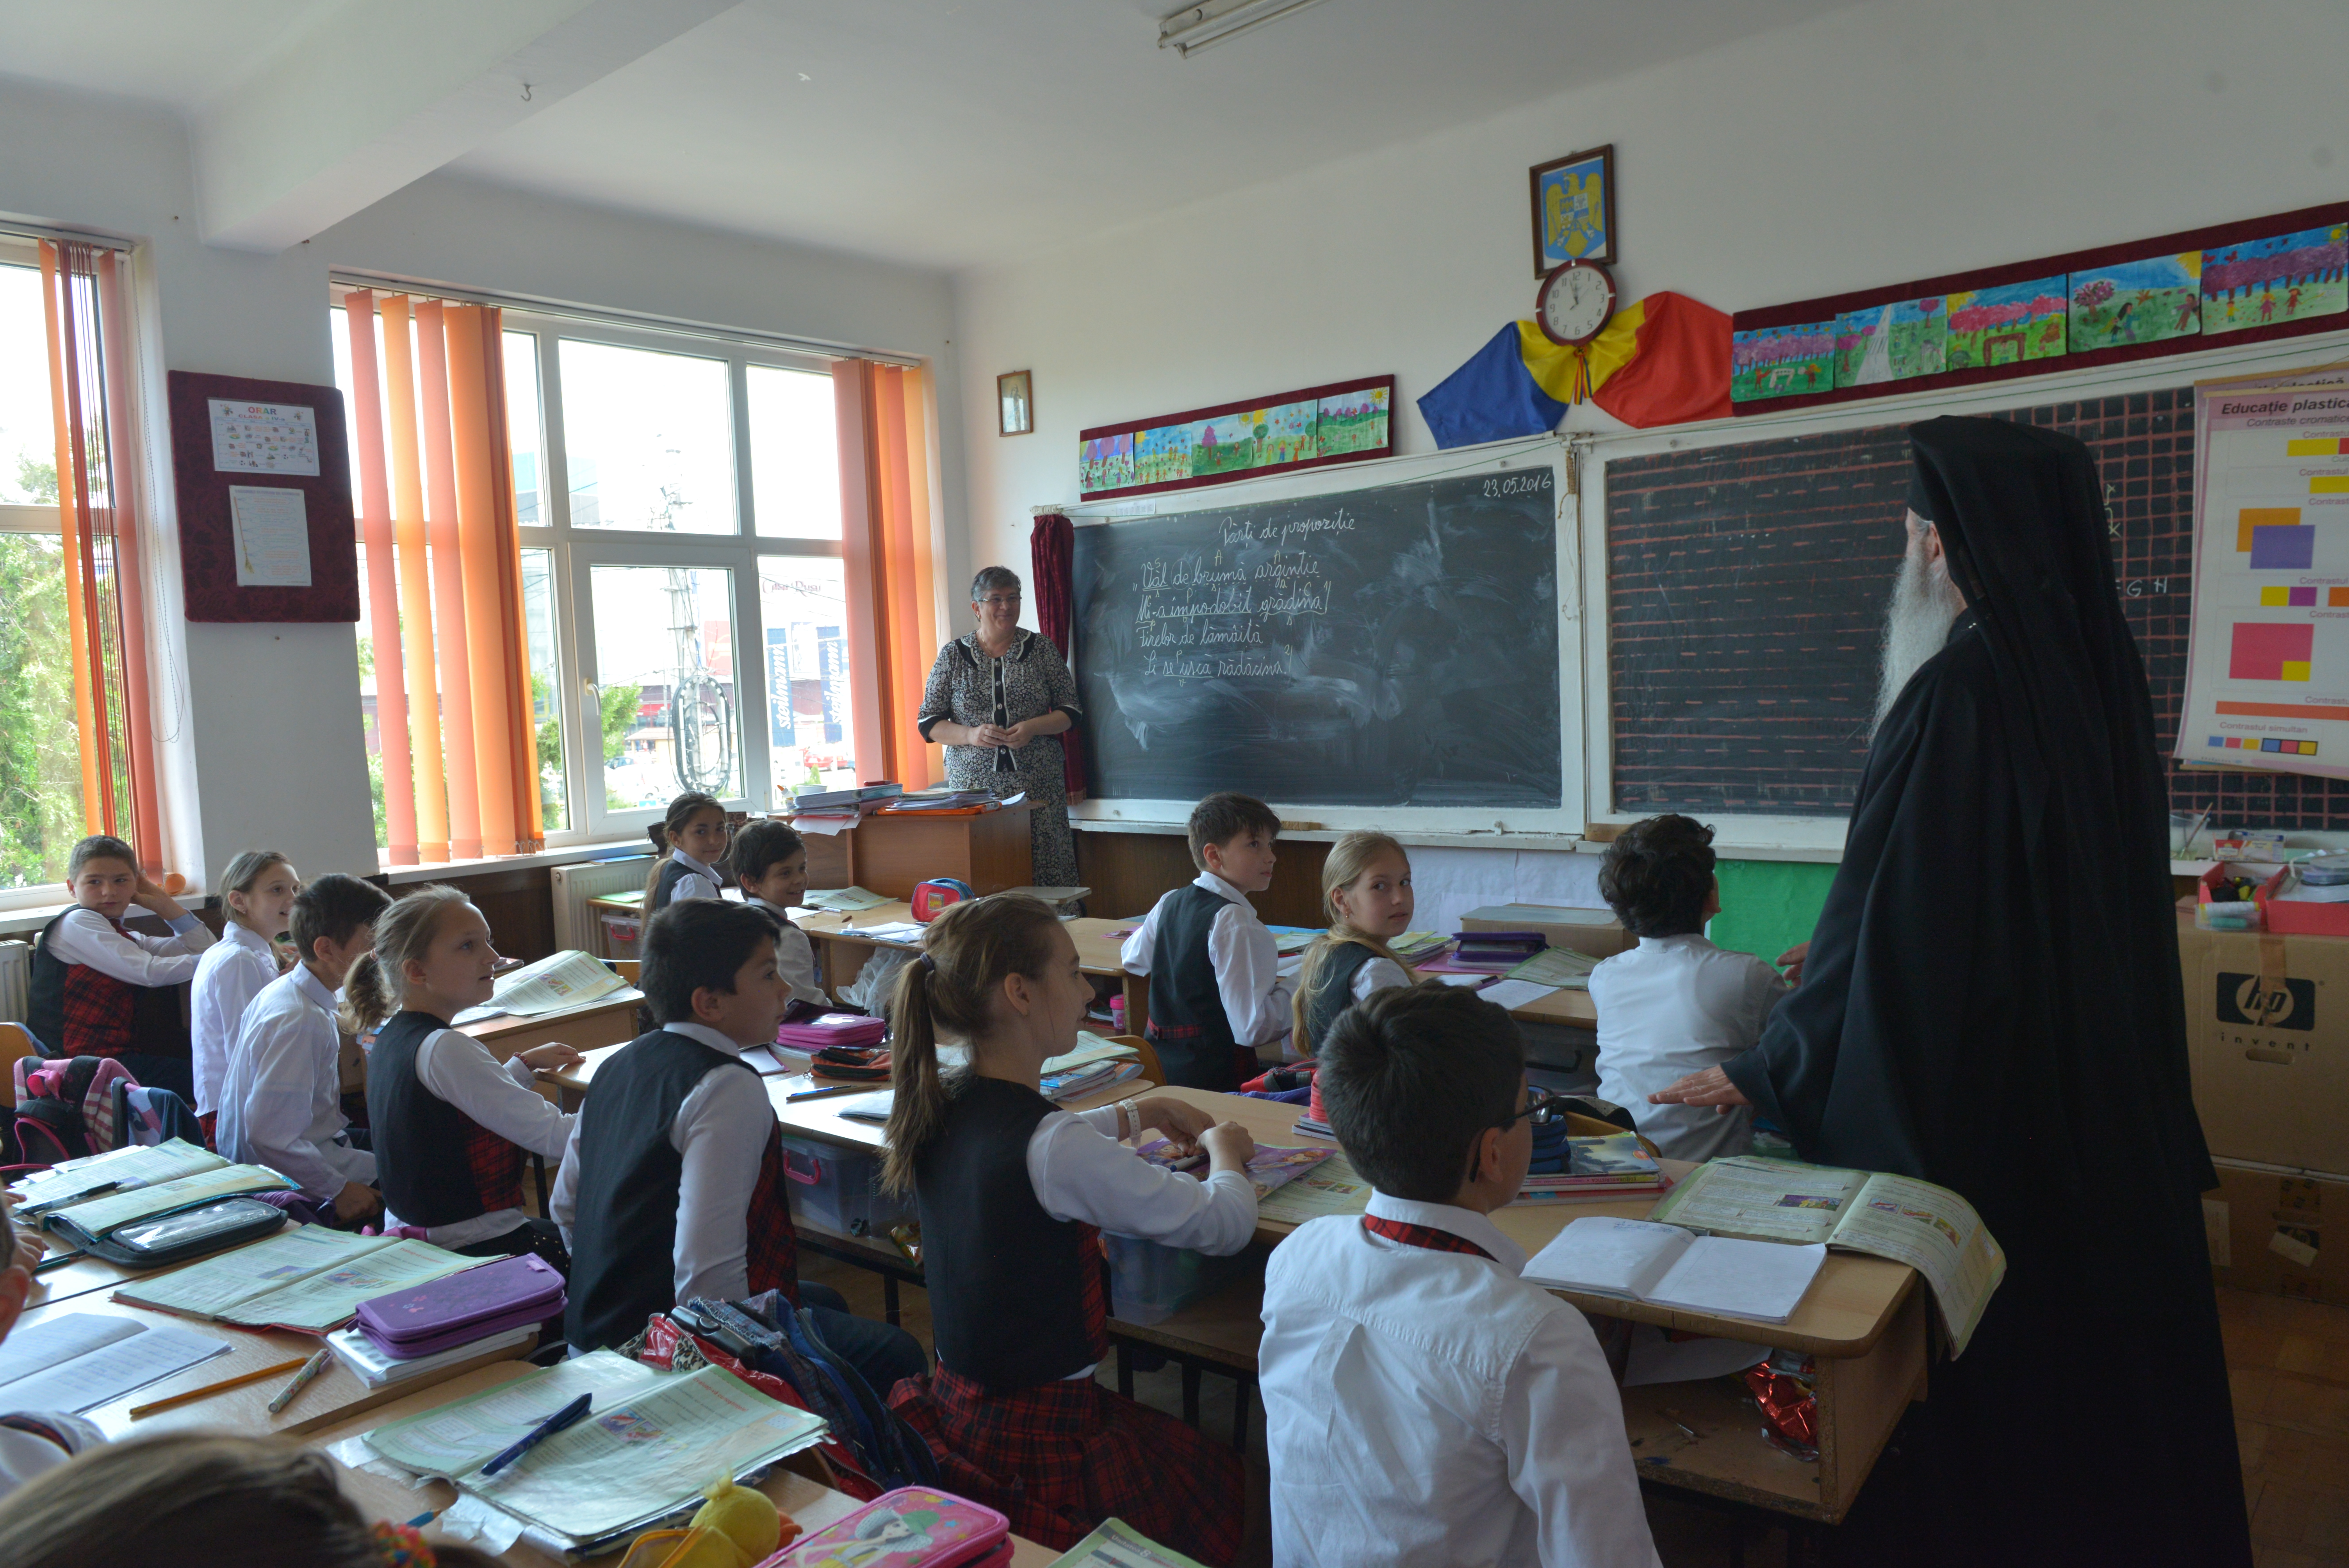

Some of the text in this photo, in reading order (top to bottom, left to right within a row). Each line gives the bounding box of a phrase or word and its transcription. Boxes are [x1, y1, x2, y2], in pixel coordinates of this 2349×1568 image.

[1573, 272, 1581, 281] 12
[1588, 273, 1591, 282] 1
[1562, 278, 1567, 287] 11
[1596, 280, 1601, 290] 2
[1552, 290, 1559, 298] 10
[1600, 294, 1605, 303] 3
[1550, 304, 1555, 312] 9
[1597, 308, 1601, 317] 4
[1554, 317, 1559, 326] 8
[1588, 320, 1593, 329] 5
[1563, 325, 1567, 334] 7
[1575, 326, 1580, 335] 6
[248, 406, 276, 415] ORAR
[2222, 401, 2288, 415] Educație
[2247, 417, 2297, 427] Contraste
[1484, 474, 1551, 497] 23.05.2016
[1260, 517, 1278, 538] de
[1173, 561, 1188, 585] de
[1192, 556, 1247, 583] brumă
[1255, 550, 1319, 588] argintie
[2127, 579, 2142, 597] G
[2154, 577, 2167, 593] H
[1171, 585, 1252, 624] împodobit
[1178, 624, 1194, 645] de
[1162, 661, 1173, 675] se
[771, 644, 791, 729] steilmann
[824, 641, 842, 723] steilmann
[2269, 725, 2308, 734] simultan
[2221, 1032, 2310, 1051] invent
[1112, 1534, 1152, 1558] Unitatea 8
